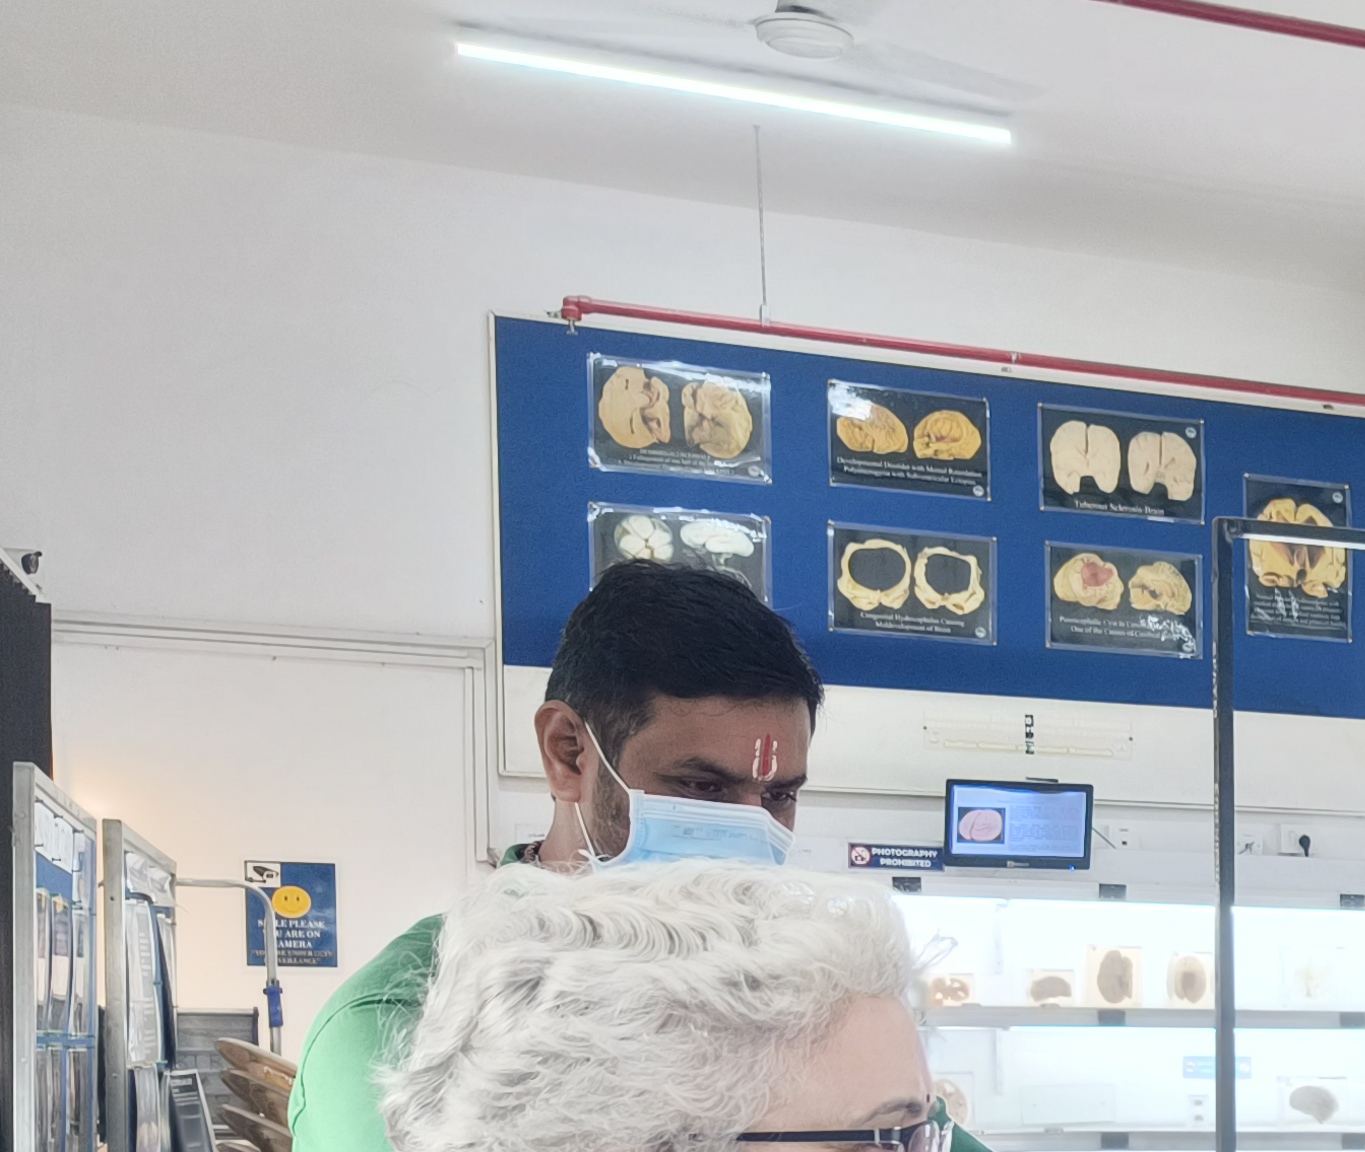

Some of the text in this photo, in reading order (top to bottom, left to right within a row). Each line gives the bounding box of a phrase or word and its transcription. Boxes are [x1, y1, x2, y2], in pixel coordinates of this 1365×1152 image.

[871, 847, 938, 858] PHOTOGRAPHY
[879, 857, 932, 868] PROHIBITED
[257, 919, 325, 929] SLE PLEASE
[285, 929, 305, 938] ARE
[306, 929, 321, 939] ON
[277, 939, 313, 949] AMERA
